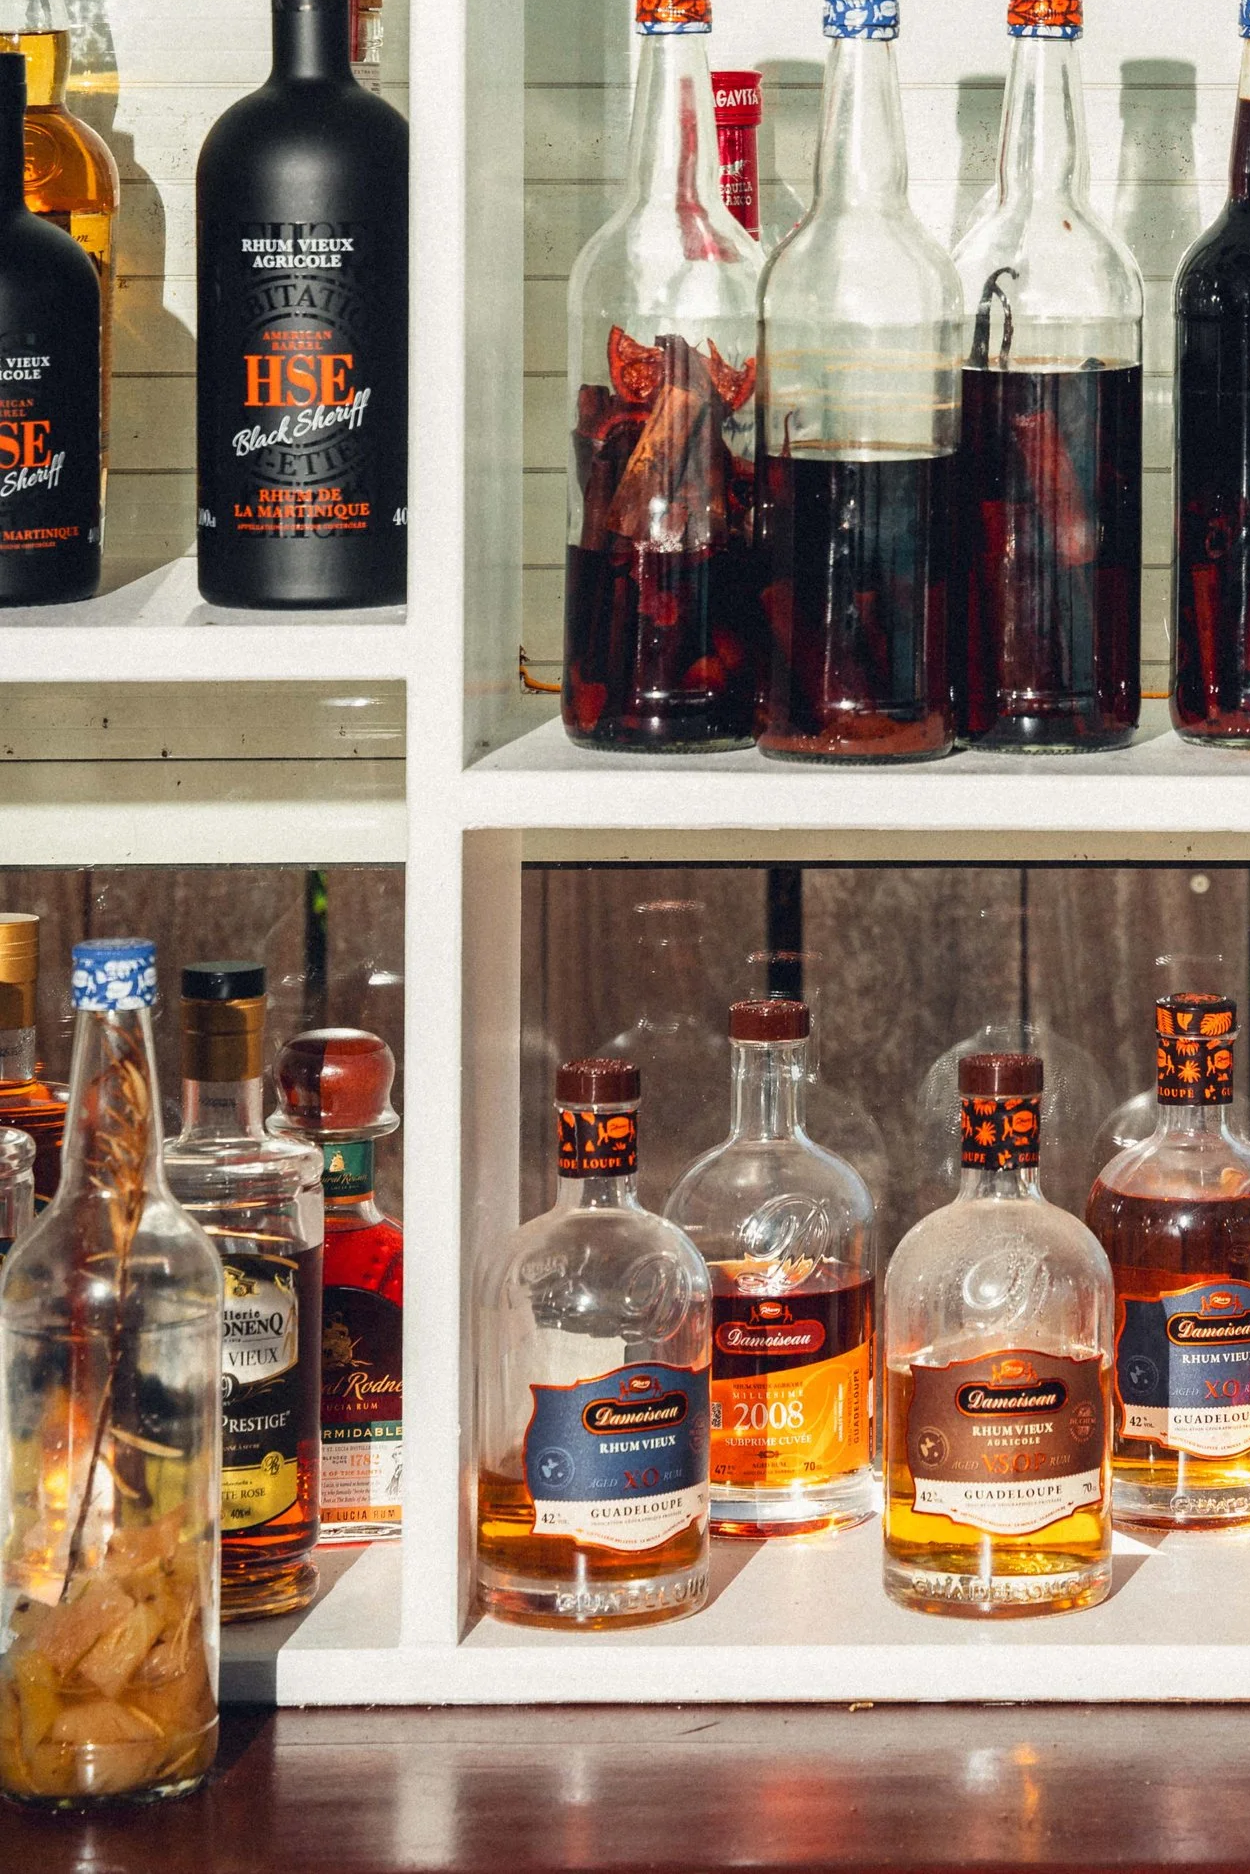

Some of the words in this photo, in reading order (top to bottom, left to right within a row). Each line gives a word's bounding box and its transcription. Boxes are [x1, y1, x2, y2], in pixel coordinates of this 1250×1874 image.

[241, 239, 293, 253] RHUM
[298, 238, 354, 252] VIEUX
[252, 254, 342, 269] AGRICOLE
[263, 330, 332, 341] AMERICAN
[271, 341, 323, 351] BARREL
[6, 356, 50, 368] VIEUX
[243, 353, 355, 407] HSE
[232, 415, 293, 456] Black
[292, 388, 372, 438] Sheriff
[259, 489, 312, 503] RHUM
[316, 489, 342, 502] DE
[234, 504, 252, 517] LA
[257, 503, 370, 520] MARTINIQUE
[3, 527, 79, 541] MARTINIQUE
[727, 1328, 811, 1348] Damoiseau
[229, 1347, 278, 1367] VIEUX
[1182, 1353, 1221, 1364] RHUM
[327, 1402, 351, 1411] UCIA
[356, 1401, 378, 1410] RUM
[968, 1390, 1056, 1410] Damoiseau
[594, 1405, 679, 1427] Damoiseau
[733, 1401, 804, 1431] 2008
[1129, 1416, 1142, 1427] 42
[324, 1427, 403, 1439] RMIDABLE
[973, 1425, 1013, 1437] RHUM
[1015, 1422, 1053, 1435] VIEUX
[600, 1440, 639, 1454] RHUM
[642, 1435, 676, 1450] VIEUX
[725, 1436, 777, 1447] SUBPRIME
[779, 1433, 812, 1445] CUVÉE
[987, 1436, 1040, 1446] AGRICOLE
[714, 1464, 727, 1475] 47
[804, 1462, 816, 1472] 70
[951, 1459, 979, 1471] AGED
[1050, 1454, 1072, 1466] RUM
[241, 1488, 266, 1498] ROSE
[964, 1484, 1063, 1500] GUADELOUPE
[1082, 1482, 1093, 1493] 70
[920, 1491, 933, 1503] 42
[591, 1497, 683, 1519] GUADELOUPE
[336, 1511, 367, 1521] LUCIA
[541, 1513, 556, 1524] 42
